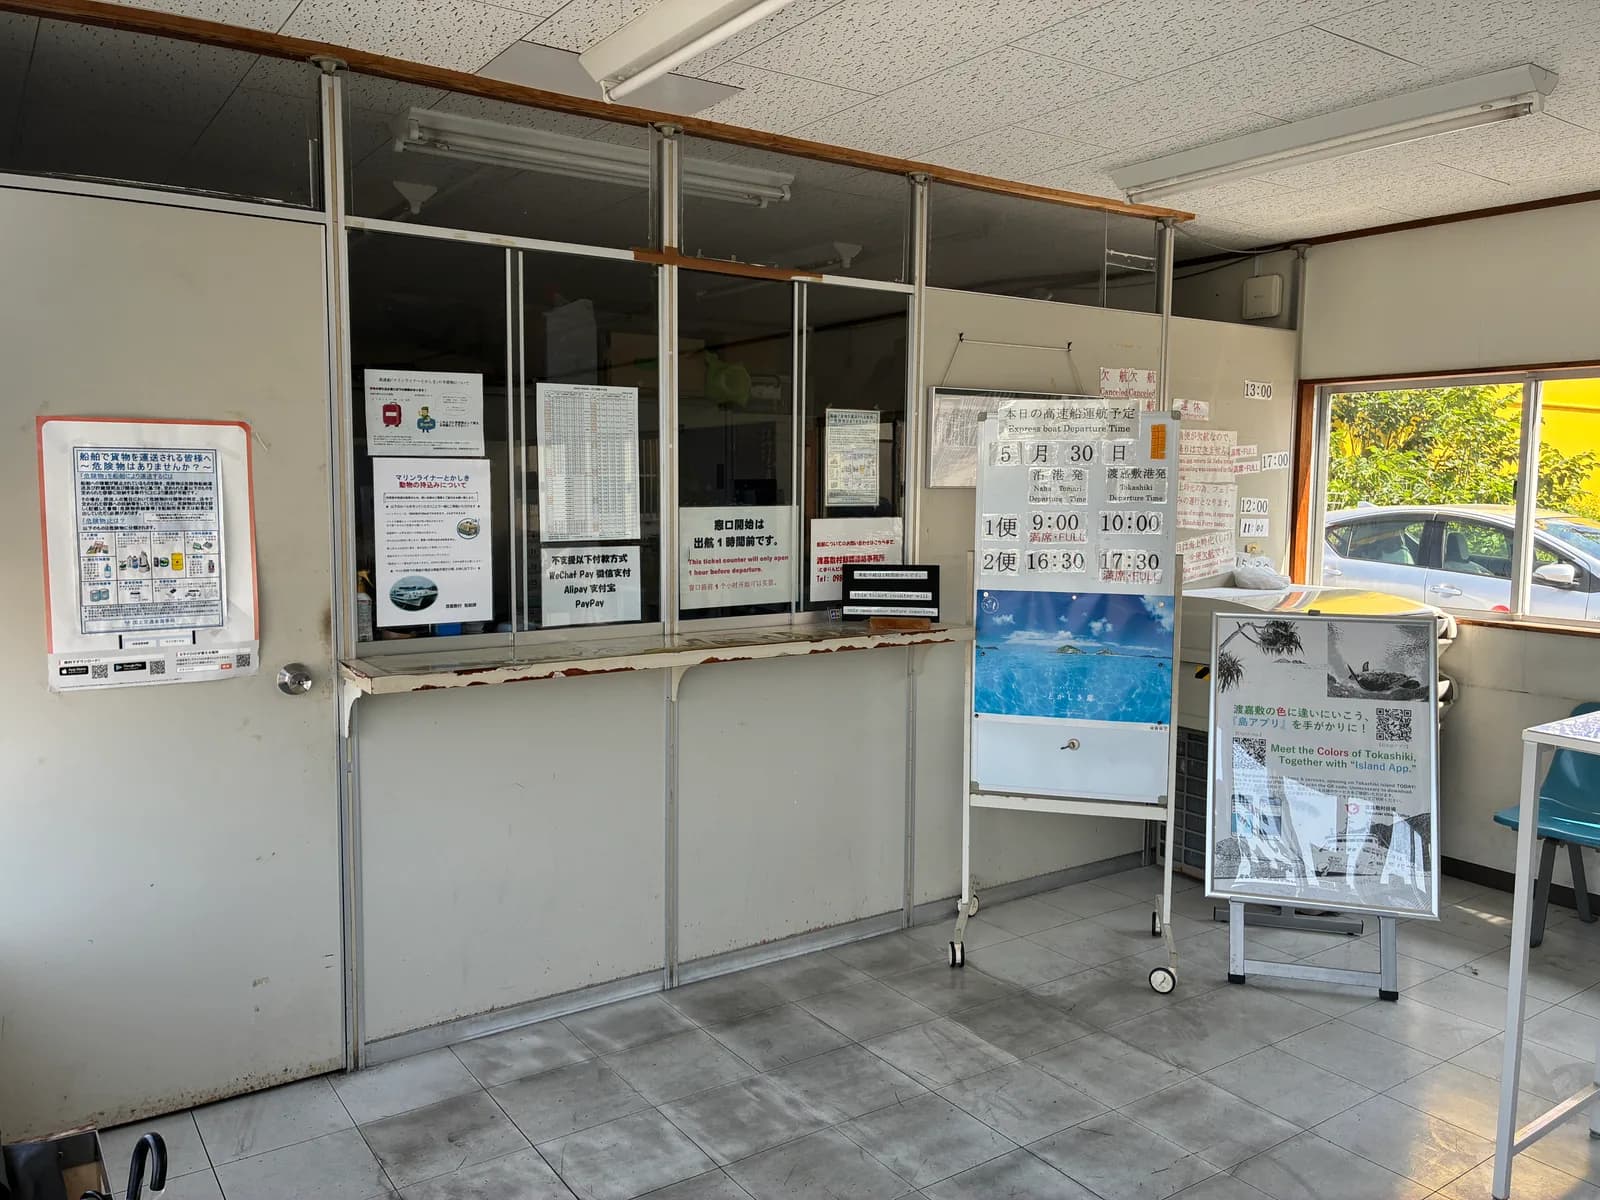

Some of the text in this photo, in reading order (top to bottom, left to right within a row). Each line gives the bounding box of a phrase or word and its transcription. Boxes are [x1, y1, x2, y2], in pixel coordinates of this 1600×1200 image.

[1244, 383, 1272, 398] 13:00
[1005, 408, 1136, 420] 本日の高速船運航予定
[1008, 424, 1131, 434] Express boat Departure Time
[1001, 444, 1126, 462] 5 月 30 日
[1262, 454, 1289, 469] 17:00
[395, 474, 470, 482] マリンライナーとかしき
[1109, 494, 1144, 502] Departure
[1241, 499, 1268, 513] 12:00
[714, 519, 764, 531] 窓口開始は
[985, 516, 1017, 537] 1便
[1032, 514, 1079, 531] 9:00
[1101, 514, 1160, 532] 10:00
[983, 551, 1017, 572] 2便
[1027, 552, 1085, 570] 16:30
[1101, 552, 1160, 570] 17:30
[549, 570, 577, 580] WeChat
[580, 570, 594, 578] Pay
[564, 584, 587, 594] Alipay
[576, 599, 604, 608] PayPay
[1270, 744, 1417, 762] Meet the Colors of Tokashiki,
[1280, 756, 1322, 769] Together
[1325, 757, 1348, 768] with
